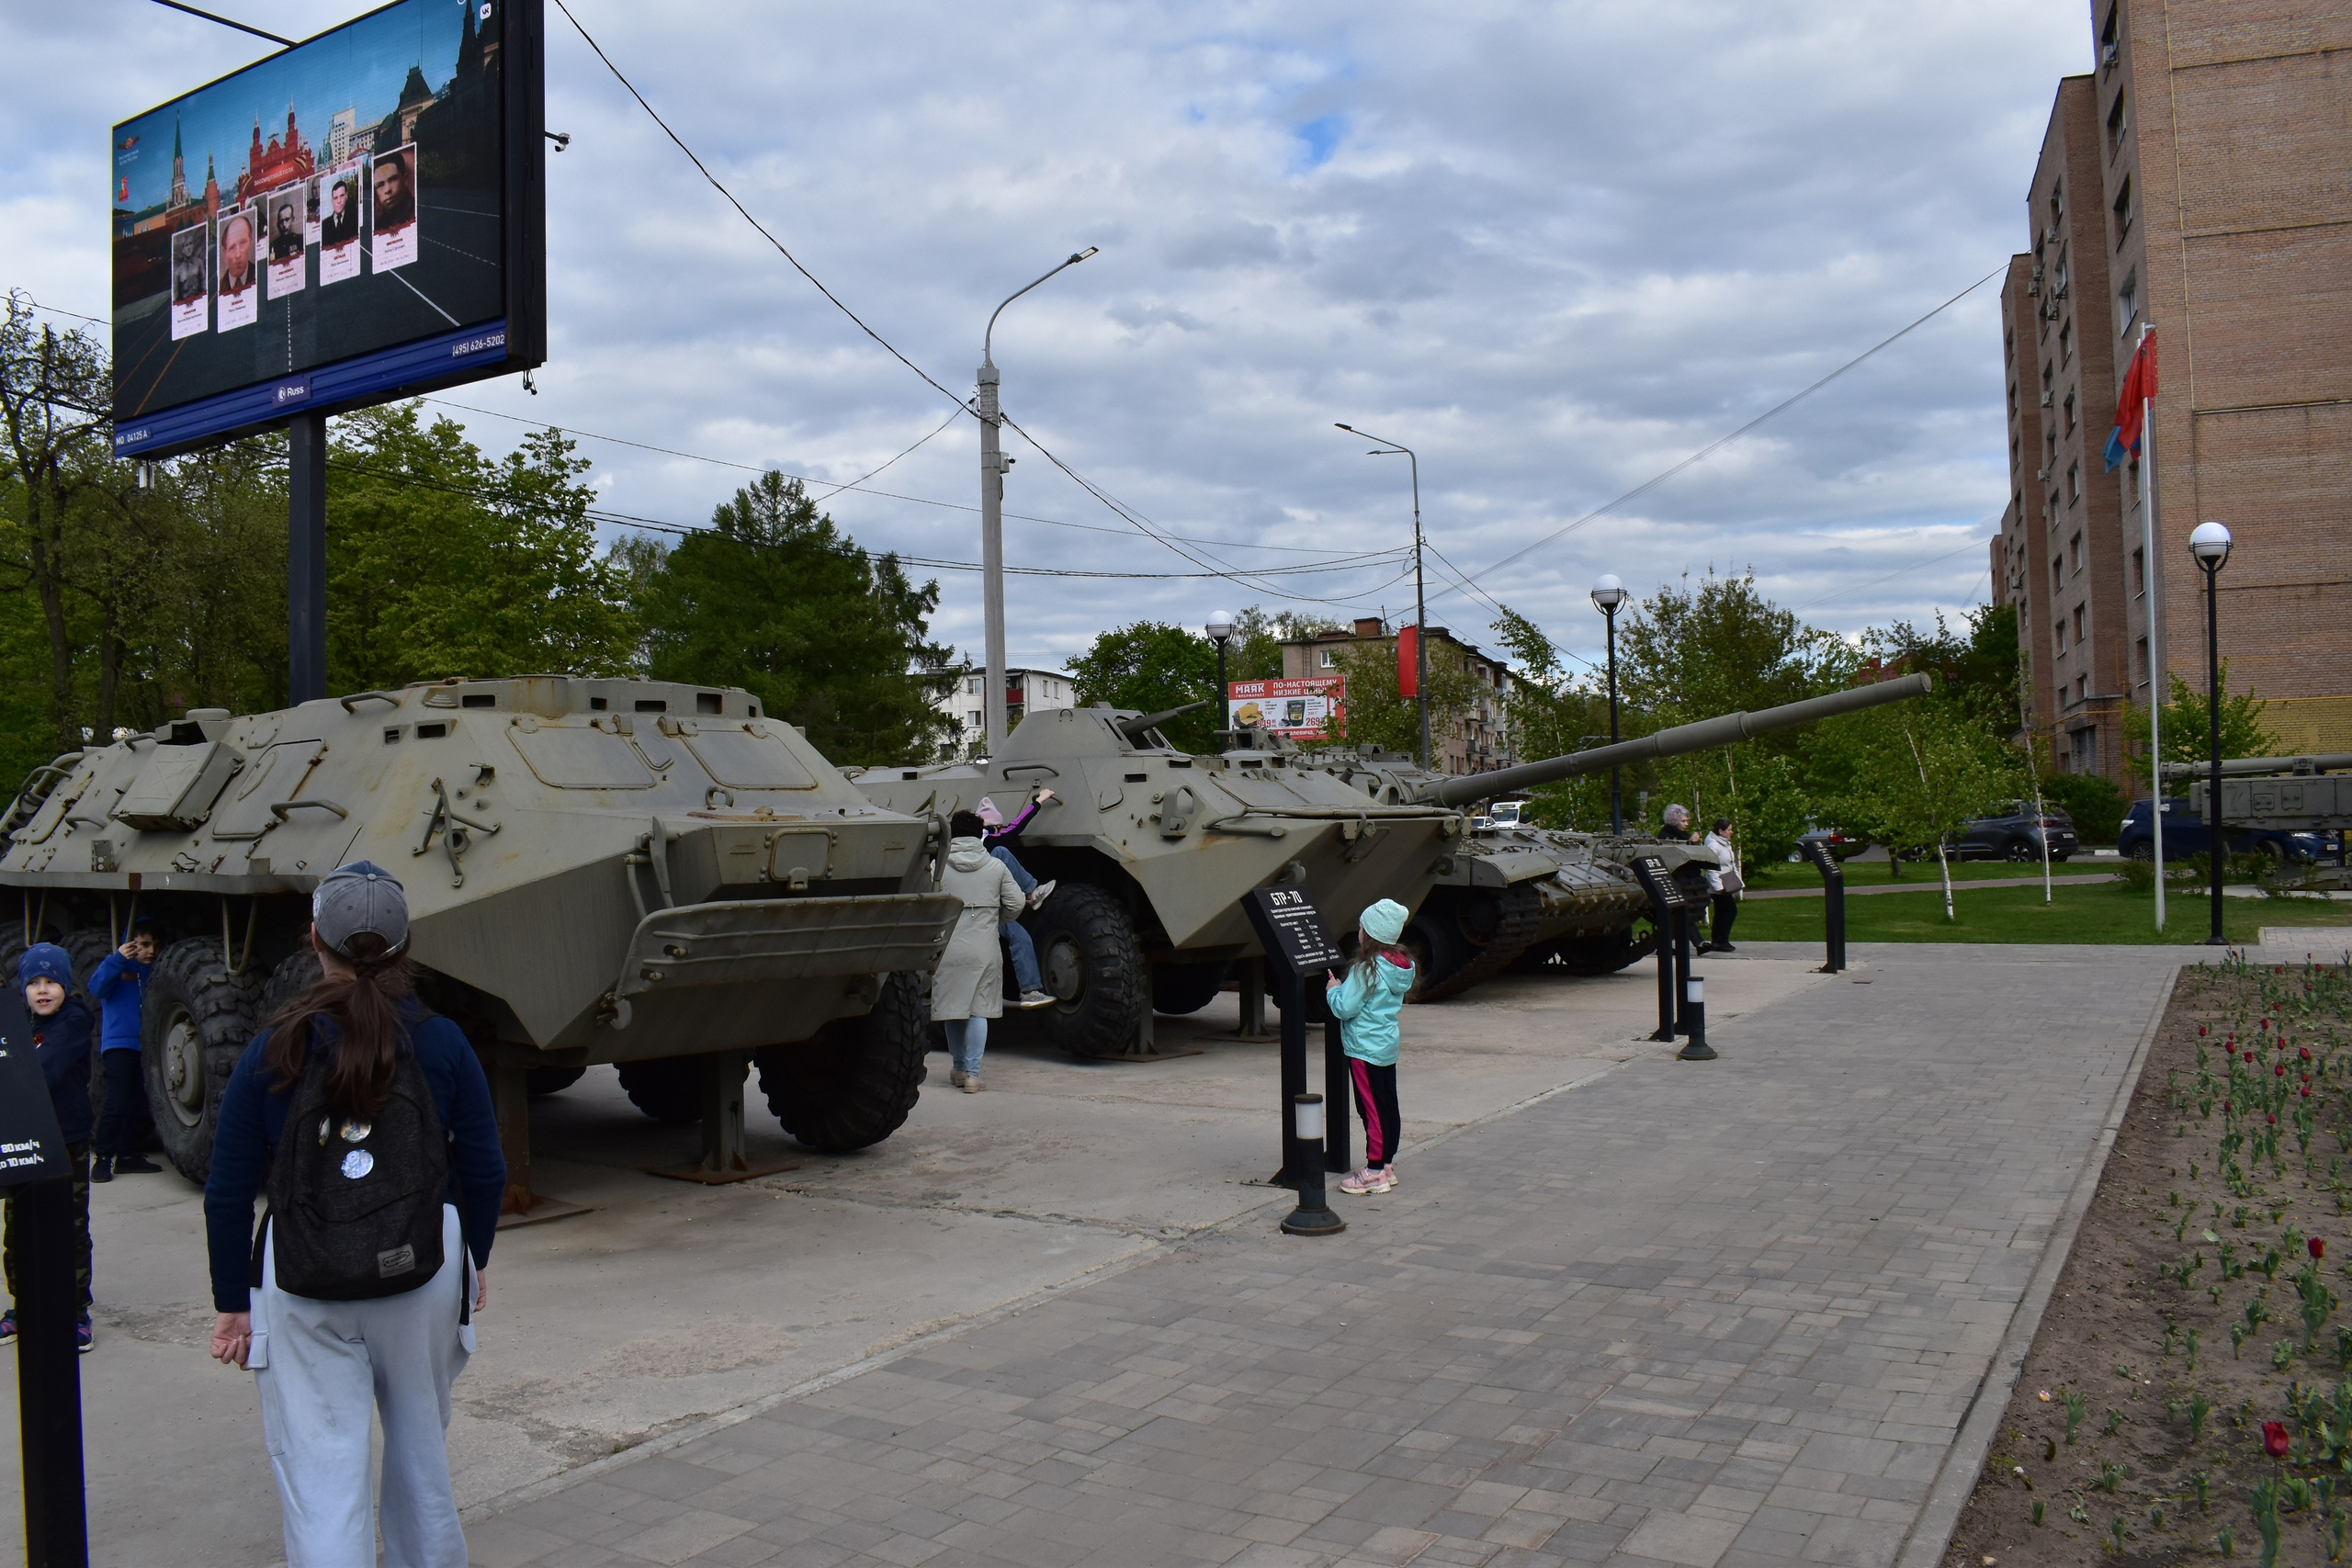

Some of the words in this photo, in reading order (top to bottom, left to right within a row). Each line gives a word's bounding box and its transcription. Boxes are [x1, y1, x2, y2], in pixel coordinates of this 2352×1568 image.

[453, 342, 469, 356] (495)
[470, 334, 504, 351] 626-5202
[288, 387, 304, 397] Russ
[1236, 683, 1265, 694] МАЯК
[1273, 679, 1337, 688] ПО-НАСТОЯЩЕМУ
